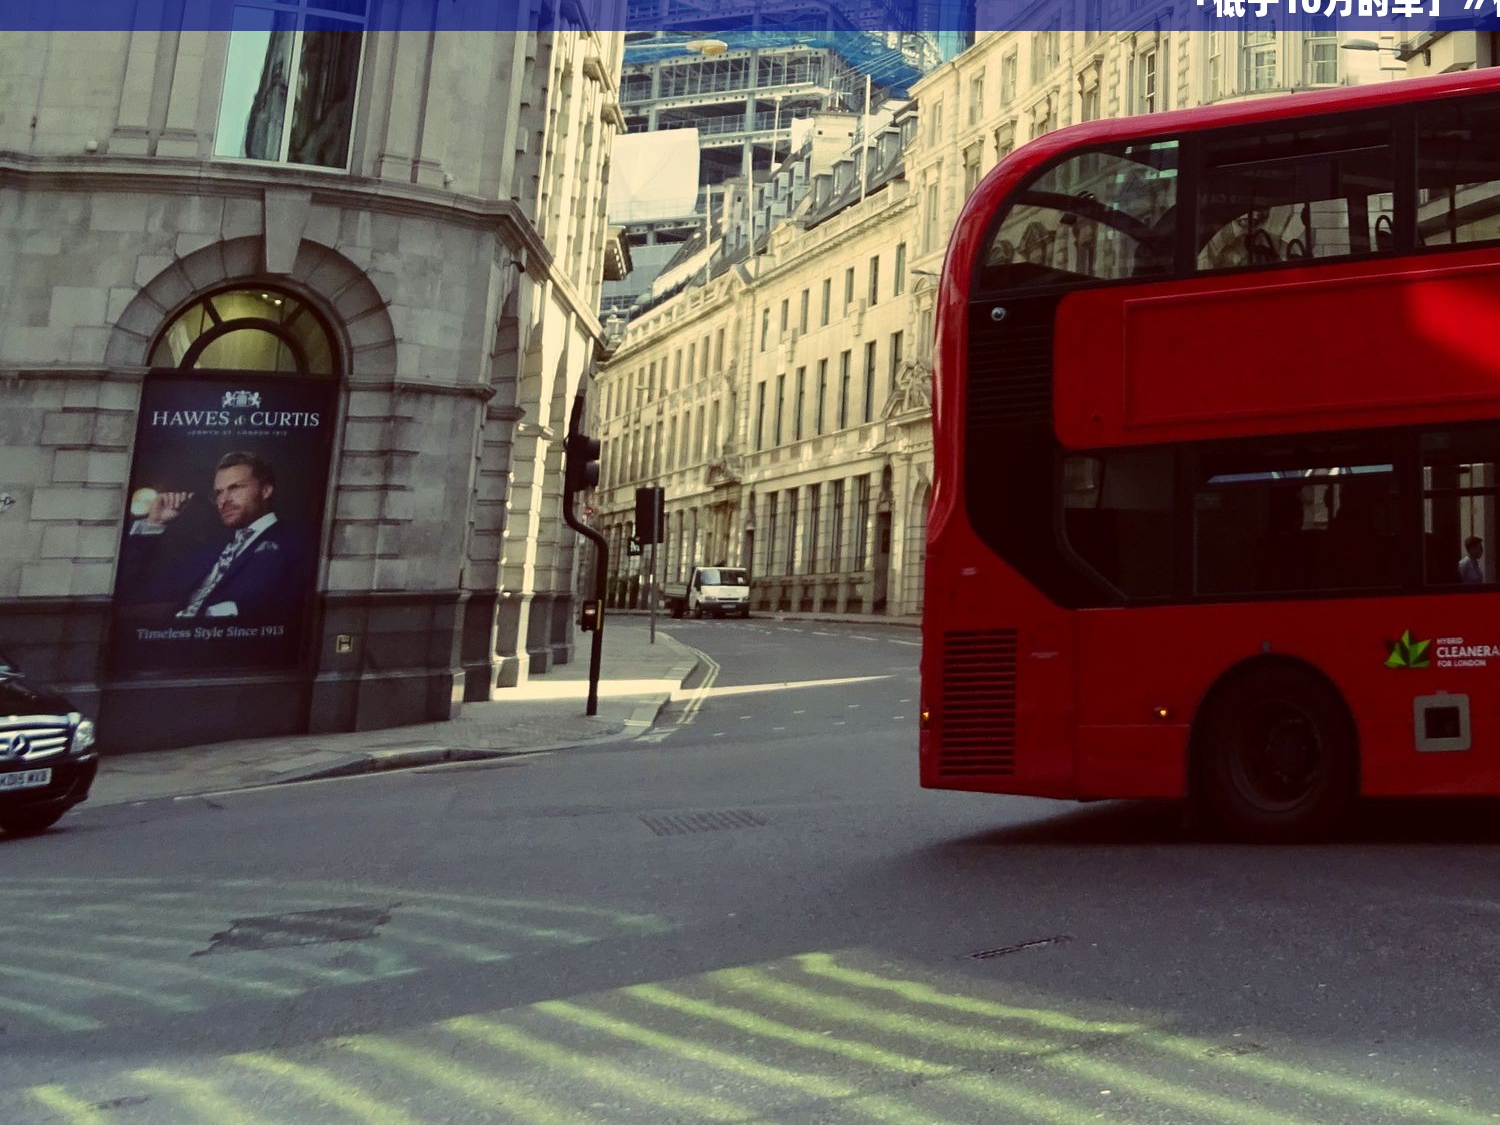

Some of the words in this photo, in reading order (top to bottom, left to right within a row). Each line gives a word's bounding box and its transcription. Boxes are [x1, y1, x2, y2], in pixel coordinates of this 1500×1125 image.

[152, 410, 230, 426] HAWES
[250, 411, 321, 427] CURTIS
[136, 628, 192, 640] Timeless
[194, 627, 224, 640] Style
[226, 626, 258, 637] Since
